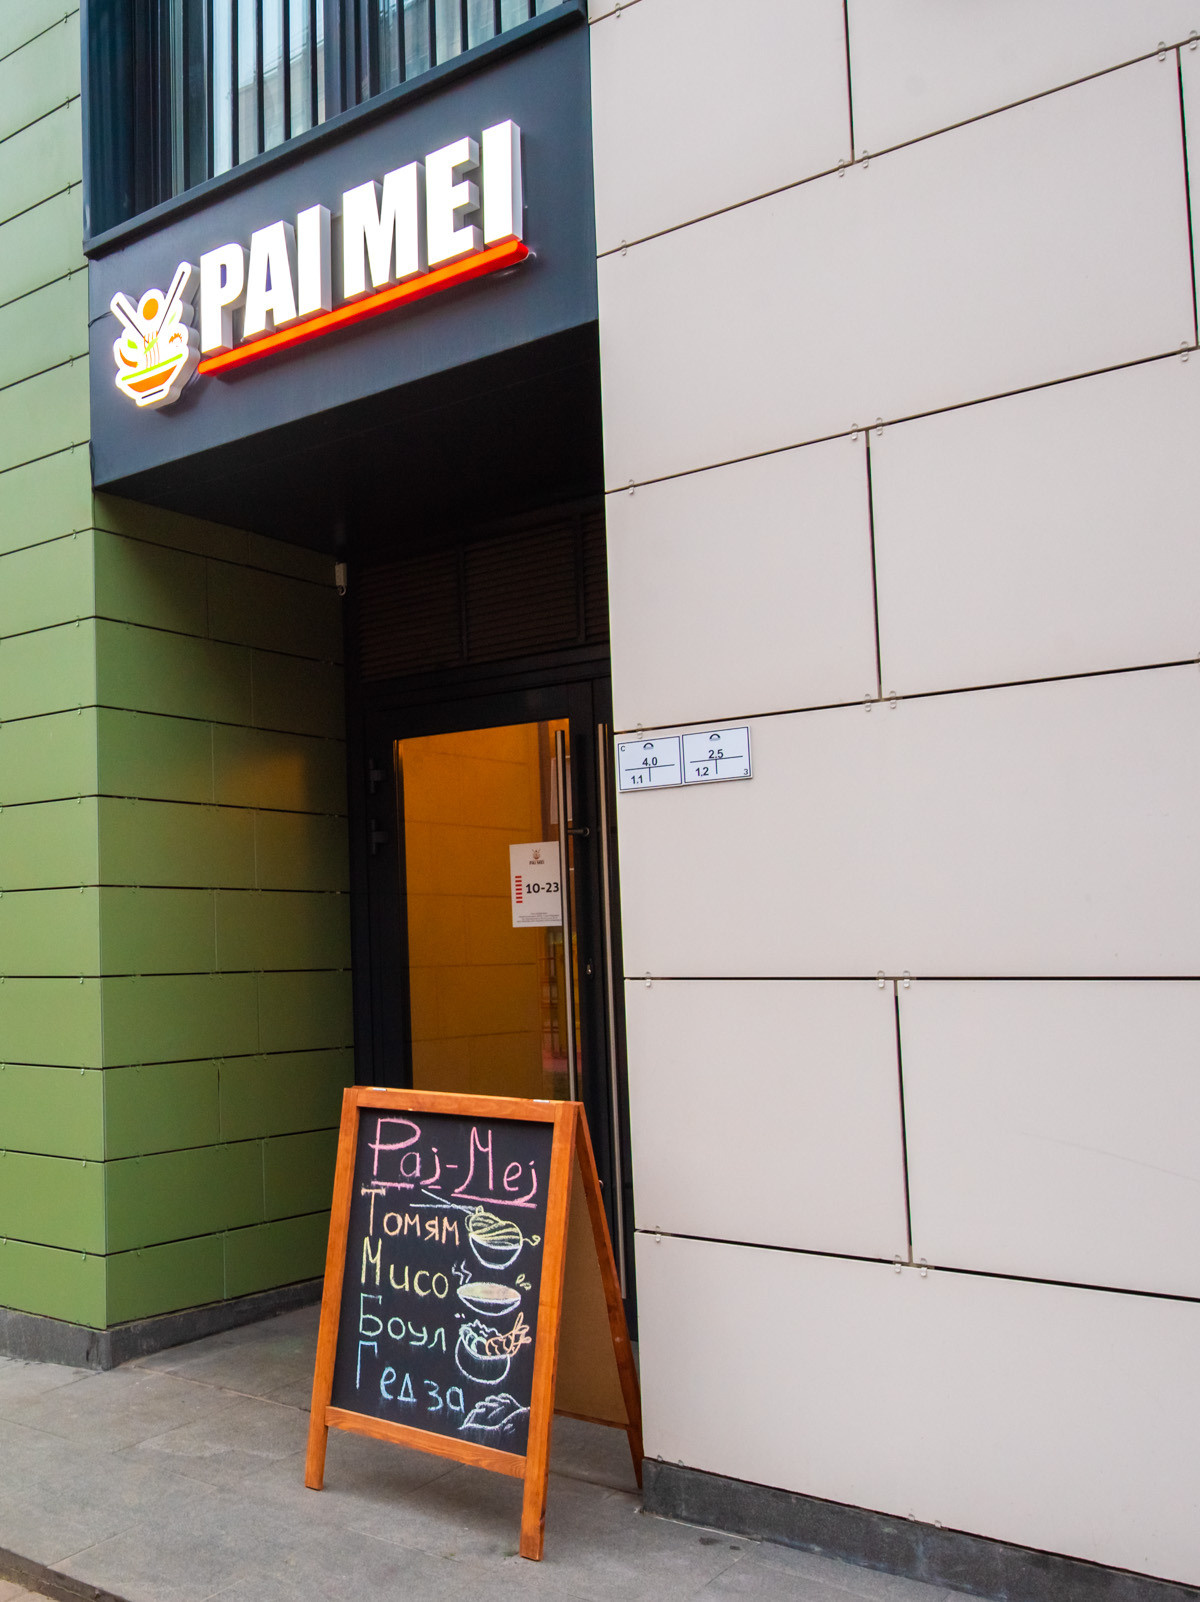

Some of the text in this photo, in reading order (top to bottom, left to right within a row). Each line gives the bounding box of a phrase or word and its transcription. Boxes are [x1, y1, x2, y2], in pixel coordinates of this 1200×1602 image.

[200, 119, 520, 354] PAI MEI
[708, 749, 724, 759] 2.5
[642, 757, 658, 766] 4.0
[695, 767, 709, 776] 1.2
[631, 775, 643, 784] 1.1
[525, 882, 559, 894] 10-23
[361, 1187, 460, 1245] Томям
[360, 1237, 449, 1299] Мисо
[359, 1293, 446, 1353] Боул
